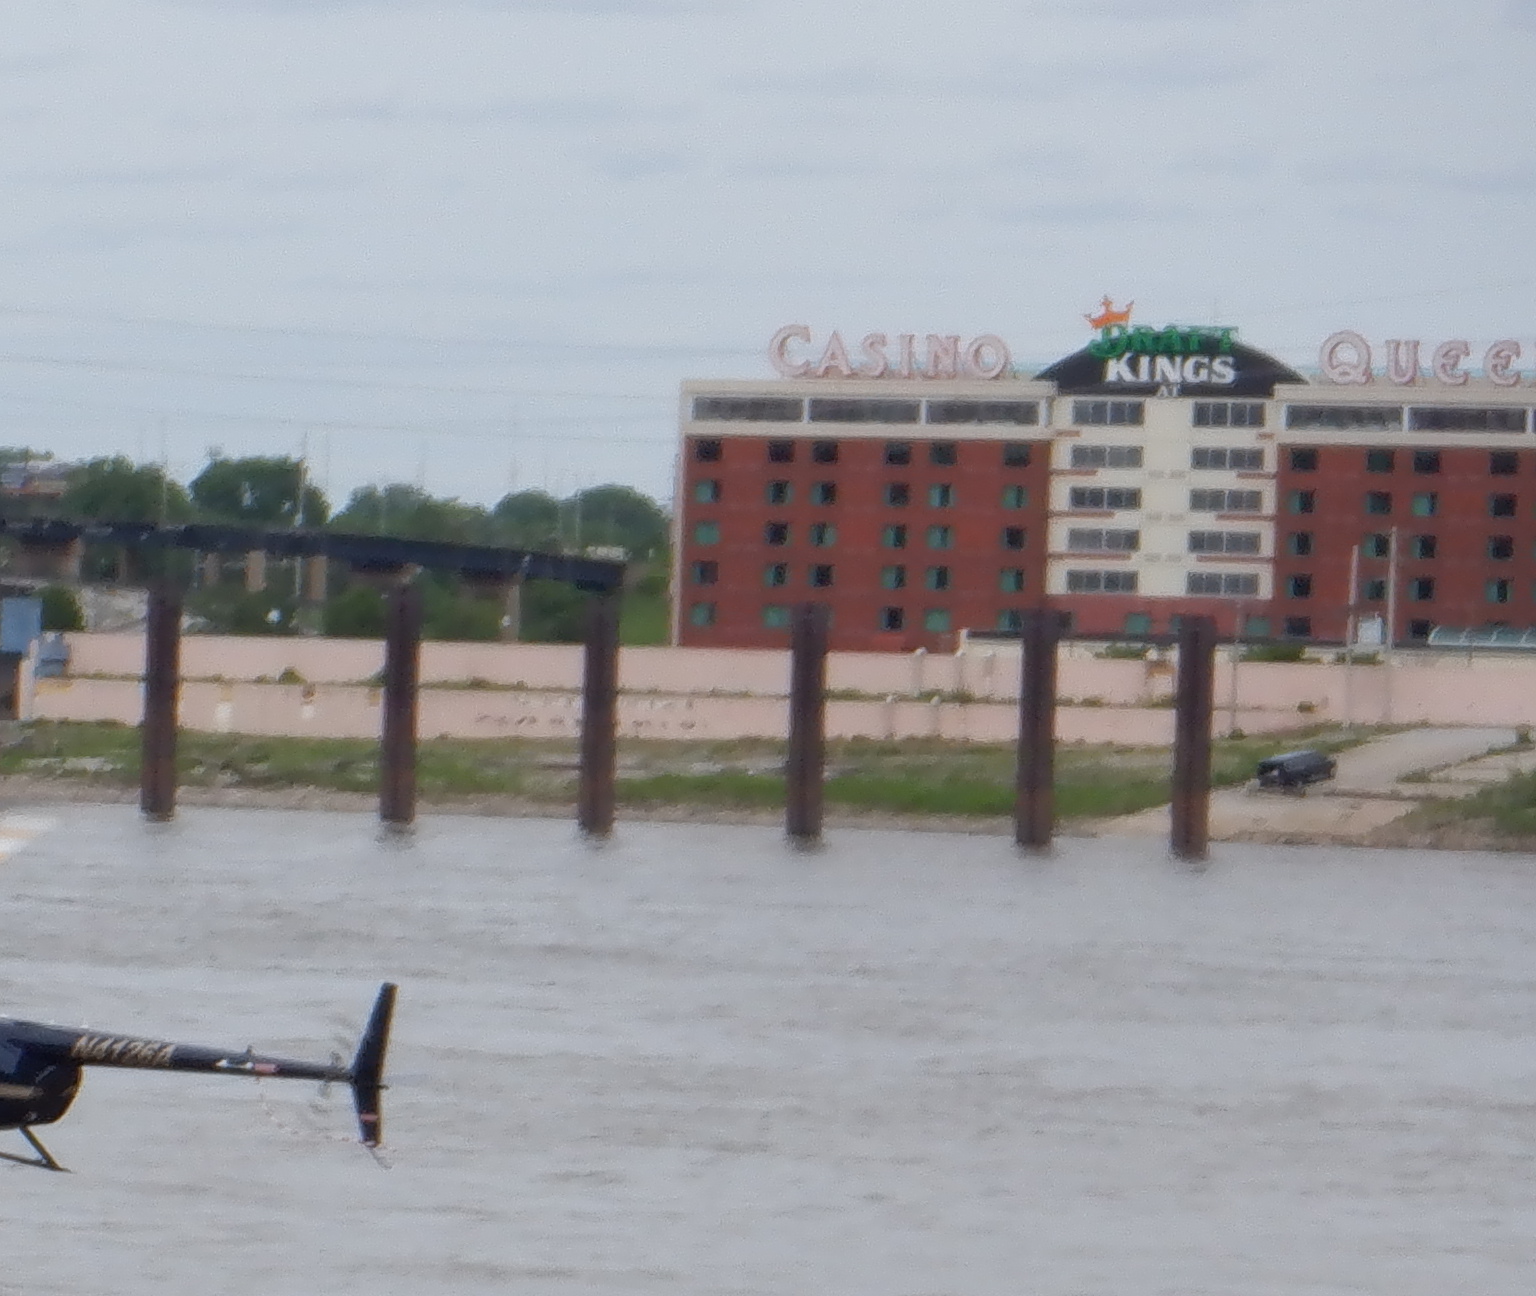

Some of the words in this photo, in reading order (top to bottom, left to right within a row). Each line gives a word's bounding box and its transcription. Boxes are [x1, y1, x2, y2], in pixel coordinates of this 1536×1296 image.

[768, 324, 1012, 380] CASINO
[1088, 324, 1239, 359] DRAFT
[1103, 353, 1238, 385] KINGS
